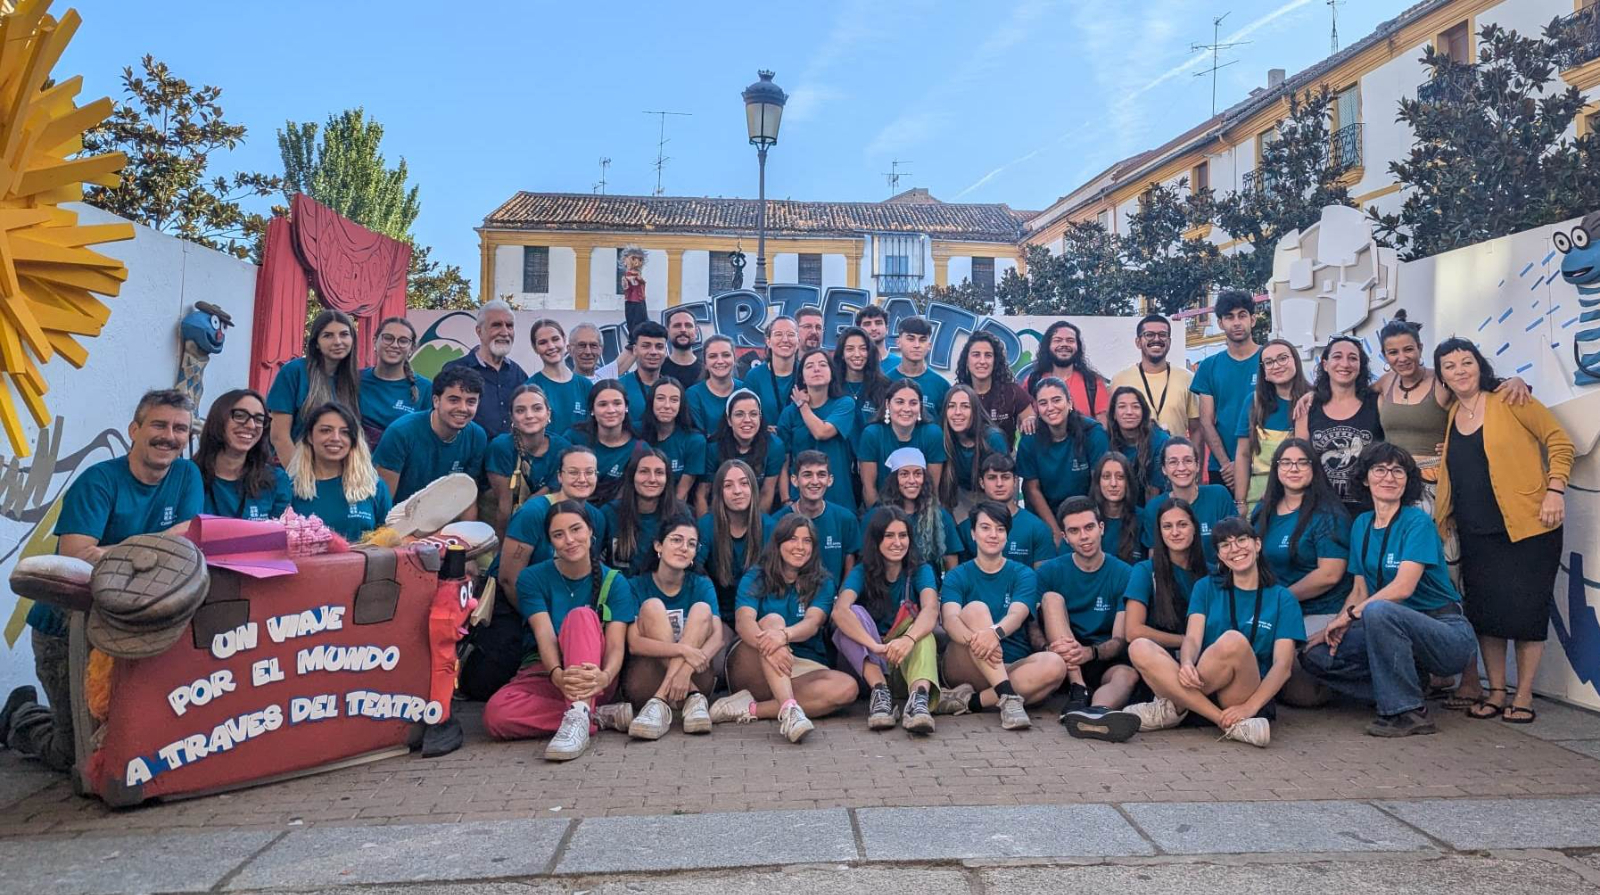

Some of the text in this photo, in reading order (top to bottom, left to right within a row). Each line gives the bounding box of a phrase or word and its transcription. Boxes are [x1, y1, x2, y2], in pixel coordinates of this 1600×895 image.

[212, 605, 346, 659] UN VIAJE
[167, 644, 400, 717] POR EL MUNDO
[126, 690, 443, 787] A TRAVES DEL TEATRO
